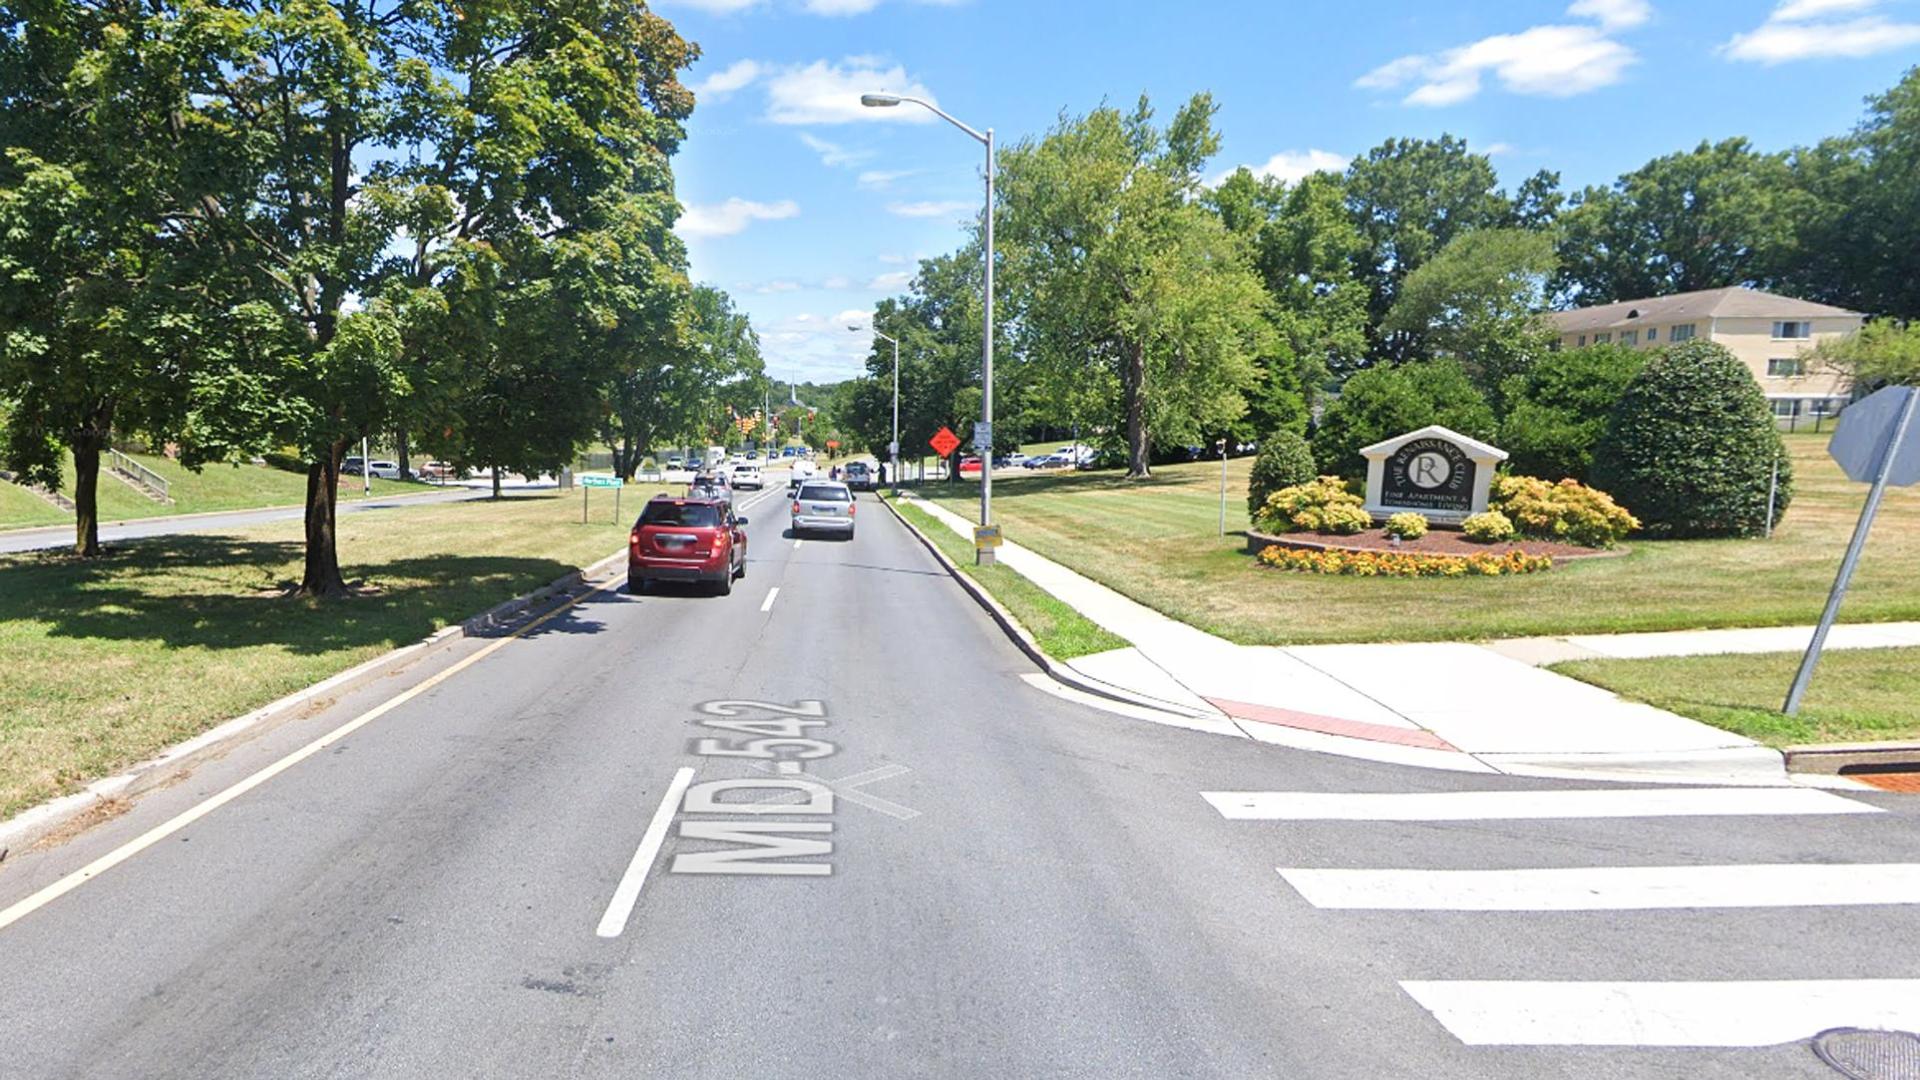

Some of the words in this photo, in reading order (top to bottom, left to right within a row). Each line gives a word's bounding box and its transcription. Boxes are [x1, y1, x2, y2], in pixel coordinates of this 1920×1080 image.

[1397, 440, 1461, 464] RENAISSANCE
[1393, 467, 1406, 487] THE
[1415, 455, 1441, 484] R
[1449, 463, 1465, 490] CLUB
[1384, 491, 1404, 499] FINE
[1408, 492, 1458, 502] APARTMENT
[1438, 502, 1470, 511] LIVING
